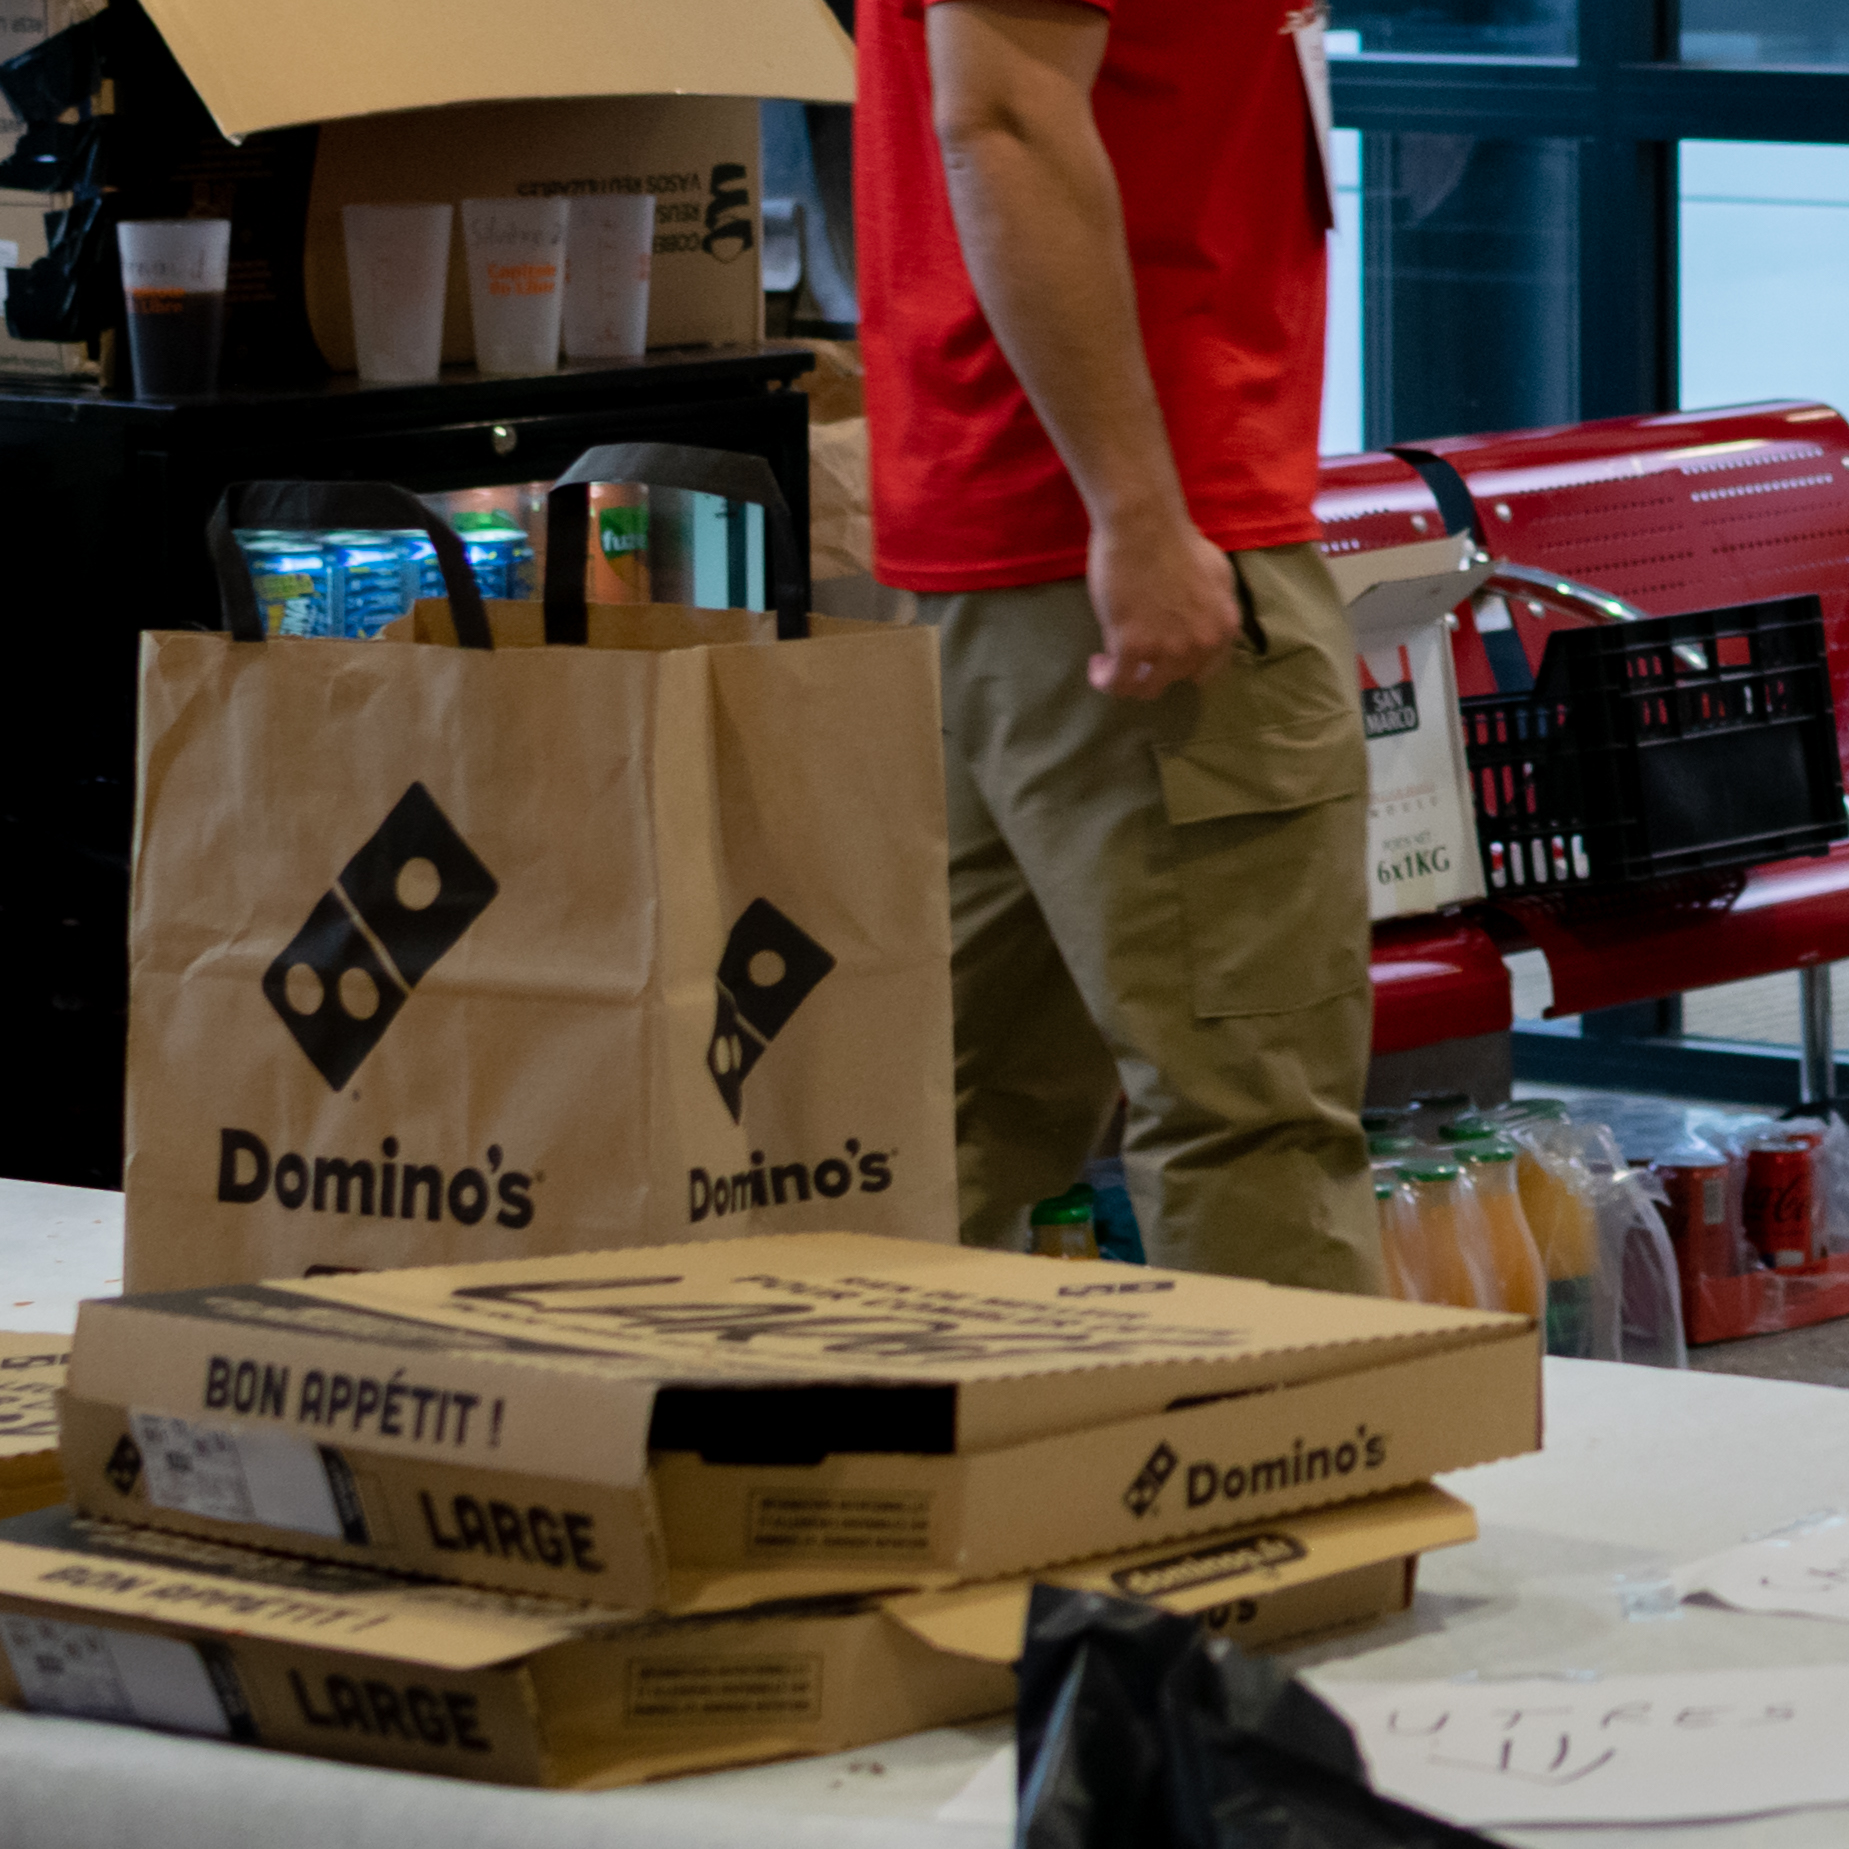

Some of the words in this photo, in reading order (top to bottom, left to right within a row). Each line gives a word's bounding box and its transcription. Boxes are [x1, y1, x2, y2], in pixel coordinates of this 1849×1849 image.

[1376, 845, 1450, 886] 6x1KG
[218, 1127, 537, 1230] Domino's
[689, 1138, 893, 1223] Domino's
[205, 1355, 292, 1420] BON
[299, 1365, 481, 1447] APPÉTIT
[488, 1399, 505, 1448] !
[1186, 1423, 1386, 1509] Domino's
[421, 1489, 607, 1574] LARGE
[38, 1563, 137, 1595] BON
[146, 1575, 351, 1632] APPÉTIT
[288, 1665, 495, 1753] LARGE
[1385, 1703, 1799, 1739] UTRES
